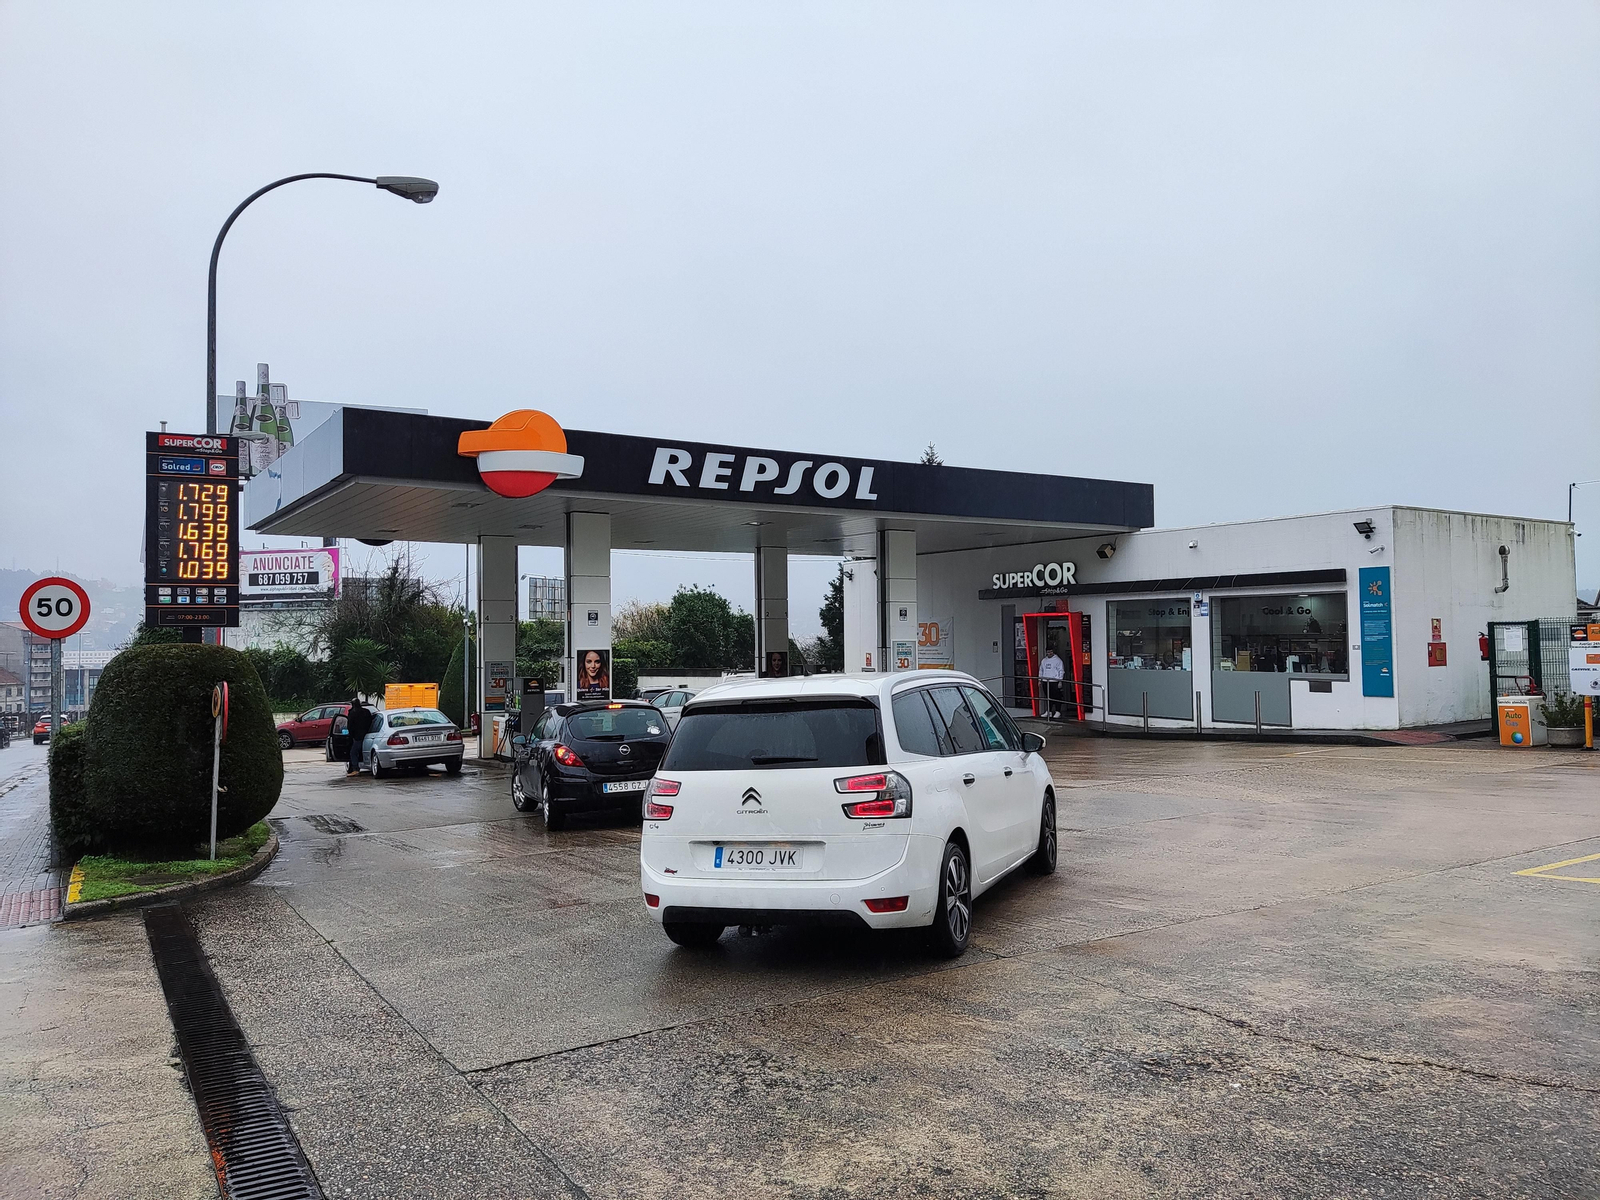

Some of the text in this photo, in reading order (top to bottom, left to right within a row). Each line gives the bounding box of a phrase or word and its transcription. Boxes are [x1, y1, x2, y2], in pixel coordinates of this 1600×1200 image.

[164, 437, 222, 449] SUPERCOR
[162, 462, 191, 471] Solred
[648, 447, 878, 500] REPSOL
[178, 483, 228, 502] 1.729
[178, 503, 228, 521] 1.799
[178, 523, 228, 541] 1.639
[178, 542, 228, 560] 1.769
[178, 561, 228, 579] 1.039
[252, 554, 315, 571] ANÚNCIATE
[258, 572, 308, 585] 687 059 757
[992, 562, 1077, 589] SUPERCOR
[37, 598, 73, 617] 50
[1148, 608, 1166, 618] Stop
[1168, 608, 1175, 616] &
[1262, 606, 1312, 615] Cool & Go
[1504, 711, 1522, 719] Auto
[608, 782, 629, 791] 4558
[727, 850, 797, 866] 4300 JVK
